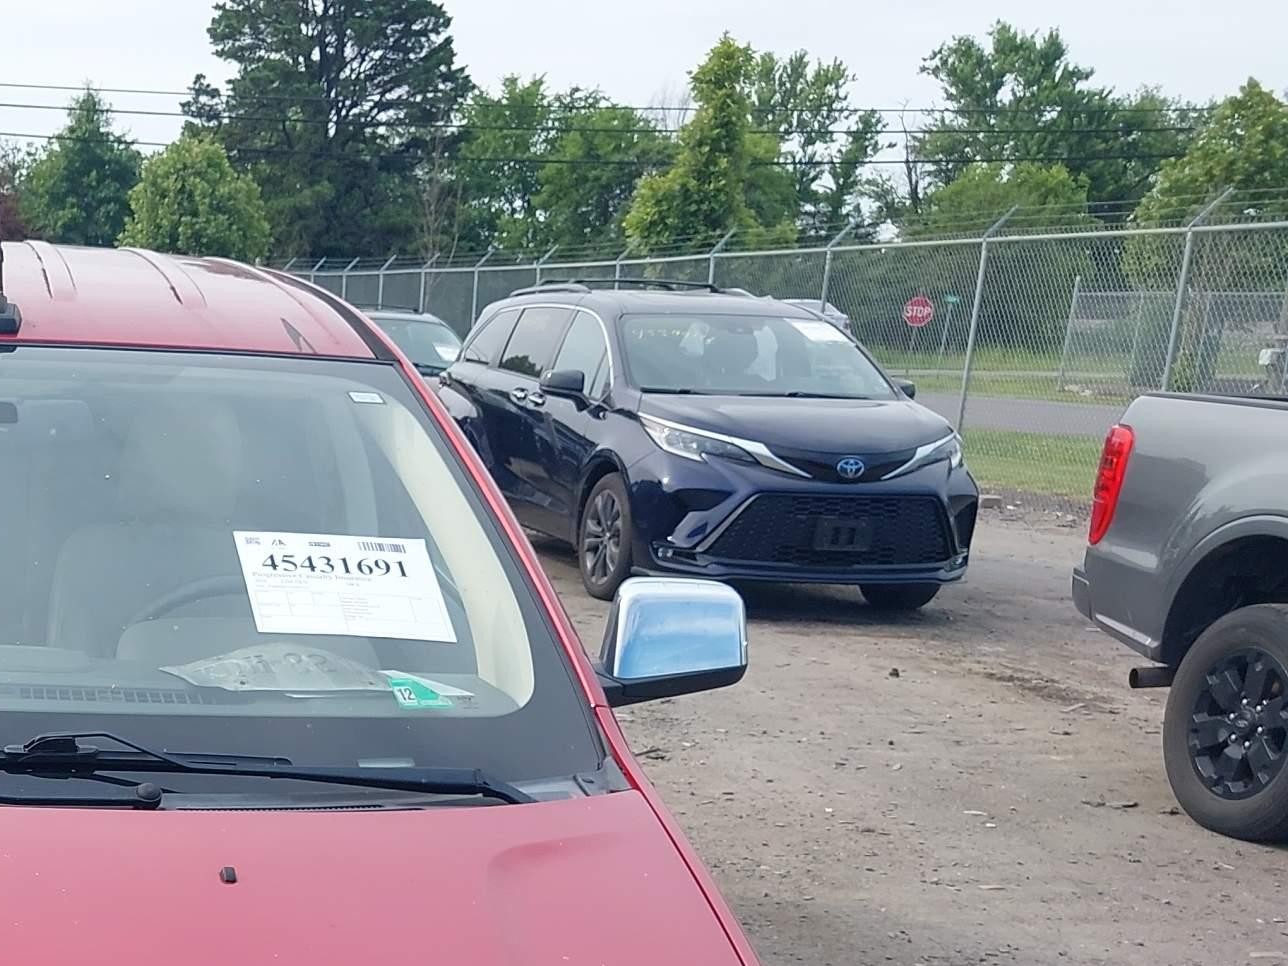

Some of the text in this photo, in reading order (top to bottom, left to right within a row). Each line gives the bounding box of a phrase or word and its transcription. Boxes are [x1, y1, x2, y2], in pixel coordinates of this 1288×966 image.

[905, 306, 931, 317] STOP
[262, 553, 409, 578] 45431691
[398, 687, 416, 701] 12
